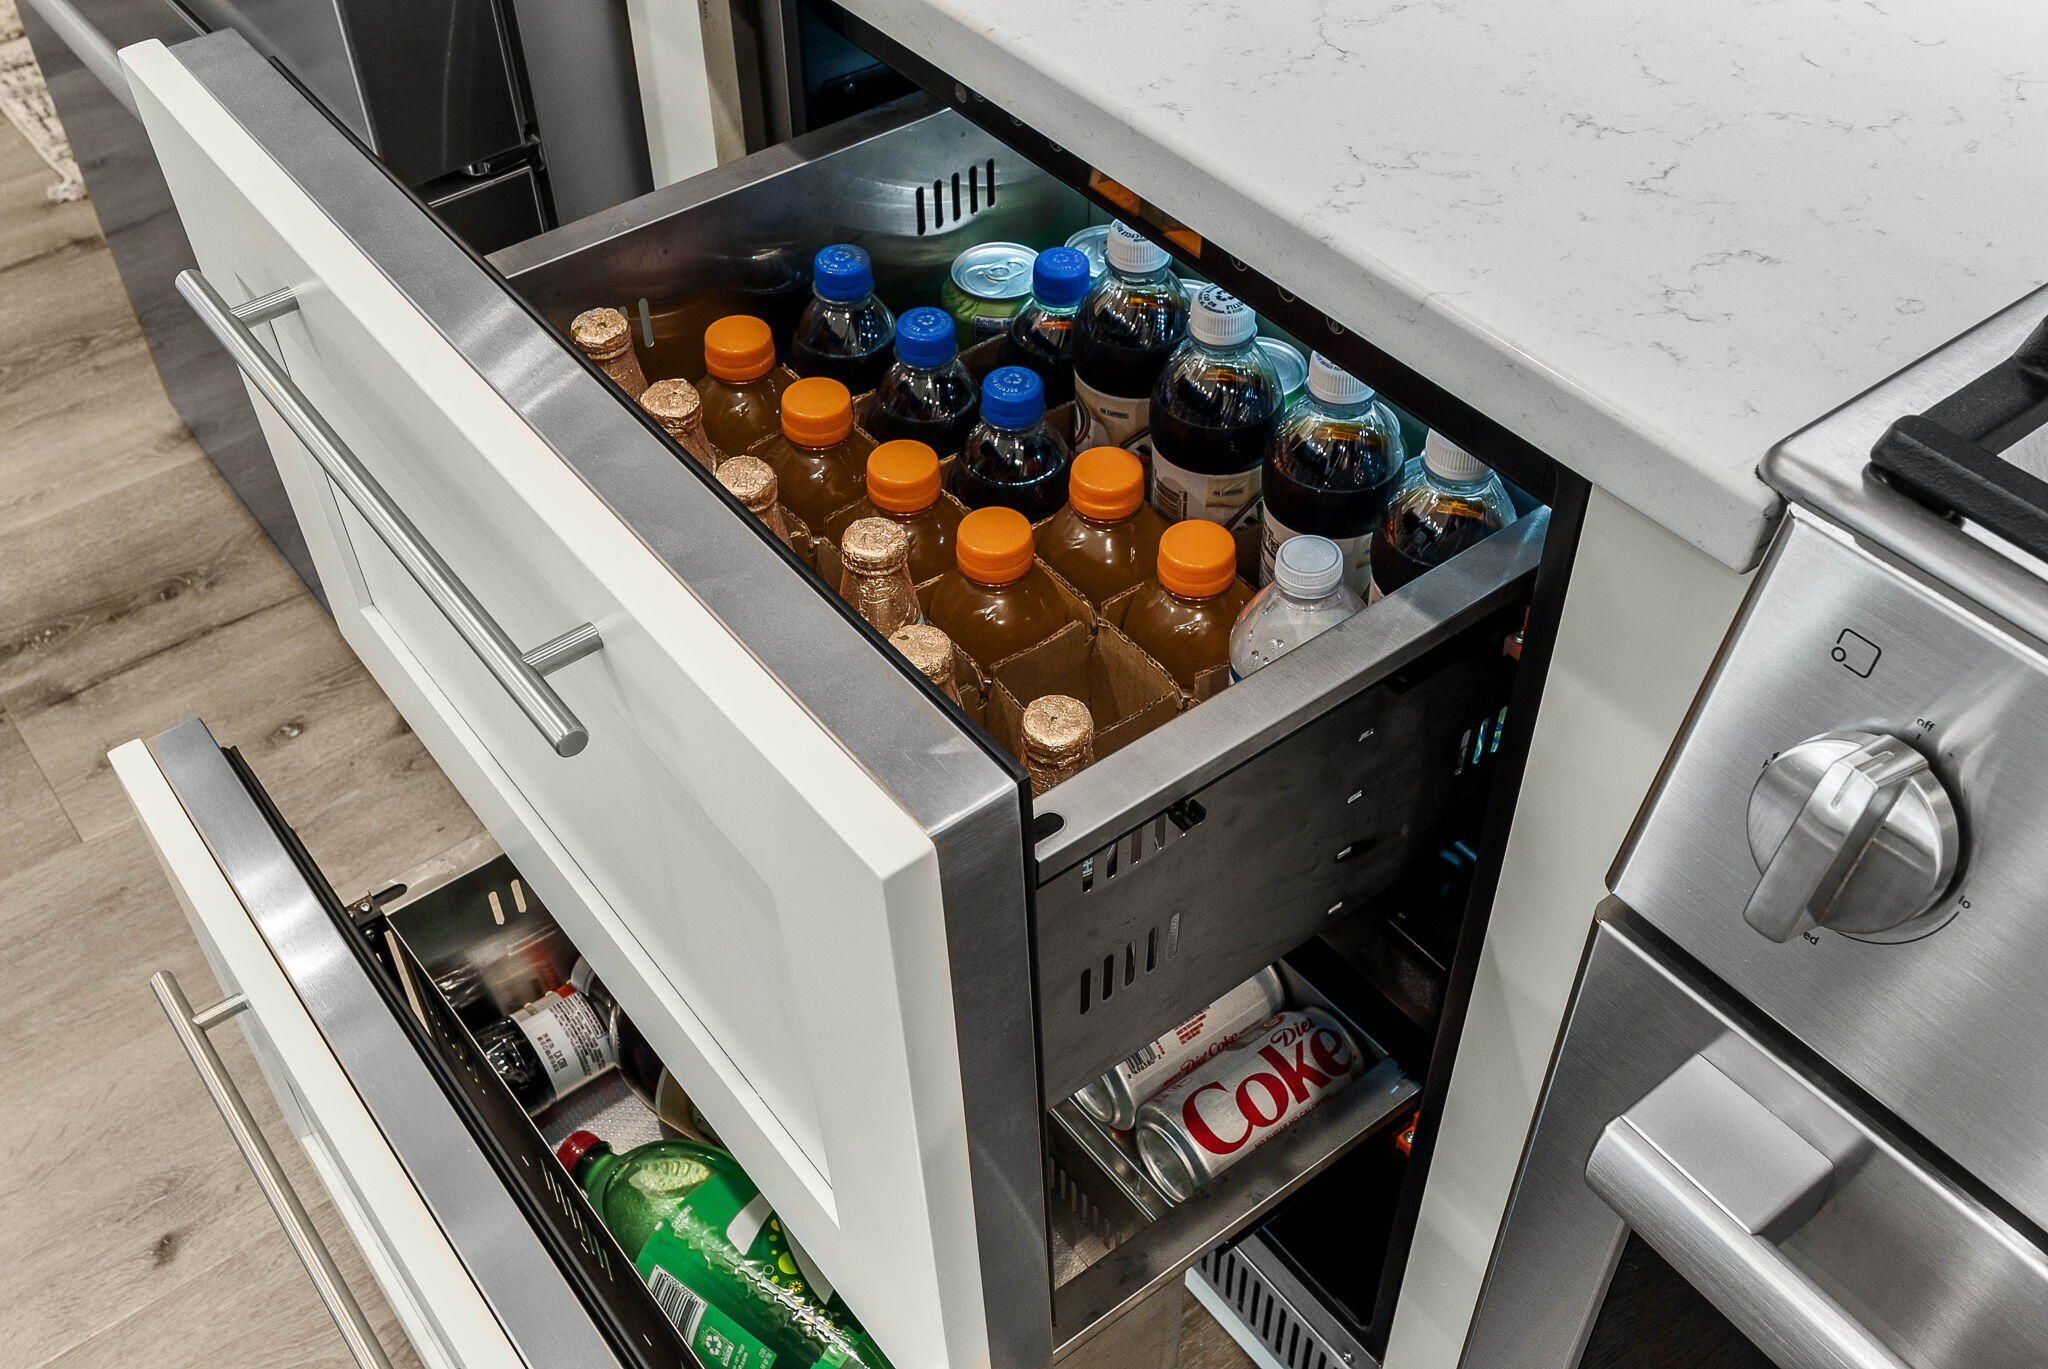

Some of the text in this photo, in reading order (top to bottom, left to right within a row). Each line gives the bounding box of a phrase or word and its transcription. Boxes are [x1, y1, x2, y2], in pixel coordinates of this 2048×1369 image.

[1916, 718, 1936, 732] off
[1958, 894, 1971, 909] lo
[1803, 931, 1820, 946] ed
[1270, 1016, 1317, 1048] Diet
[1180, 1032, 1238, 1074] Diet Coke
[1182, 1028, 1351, 1155] Coke
